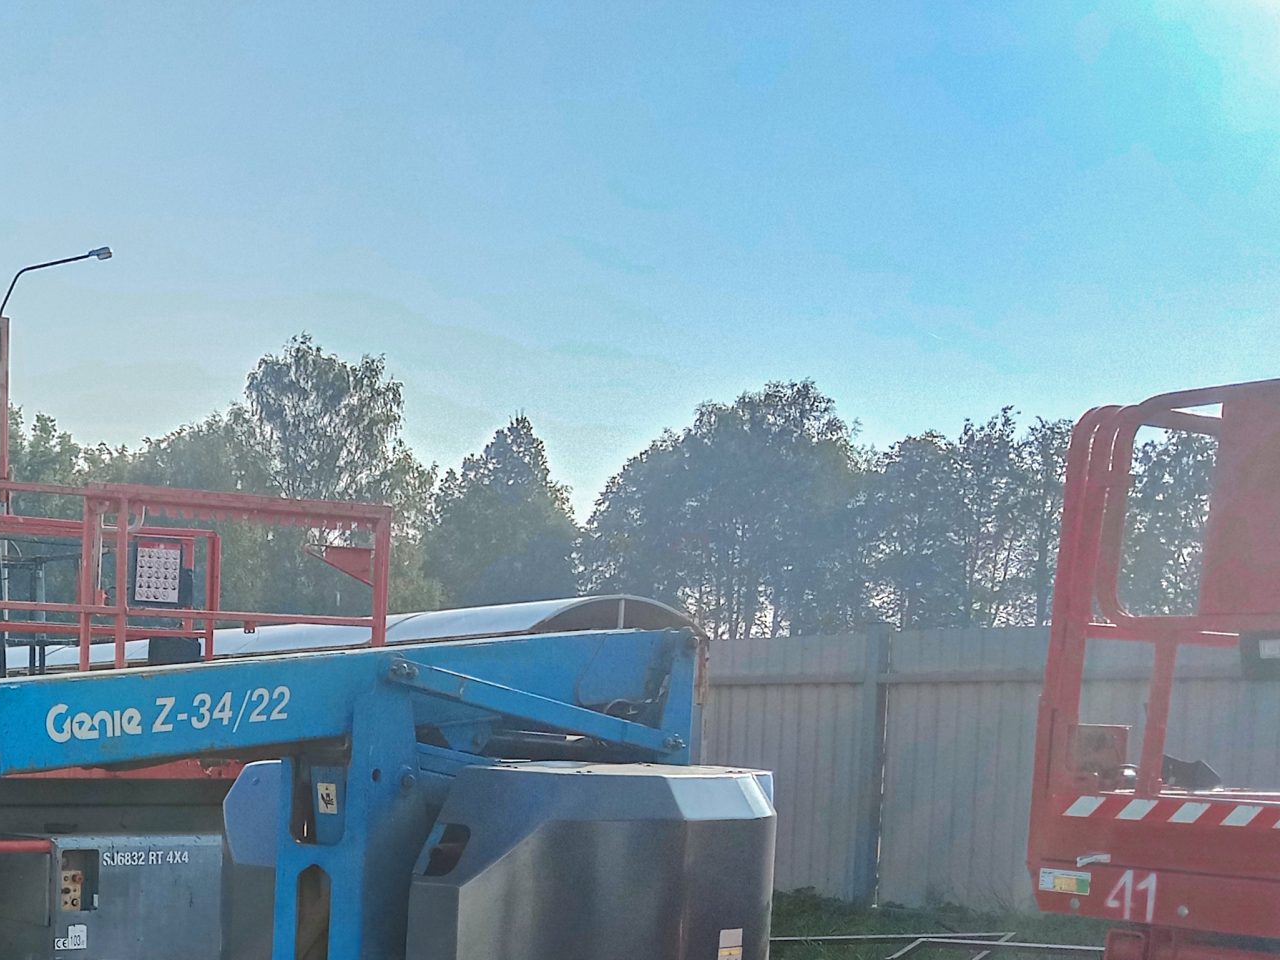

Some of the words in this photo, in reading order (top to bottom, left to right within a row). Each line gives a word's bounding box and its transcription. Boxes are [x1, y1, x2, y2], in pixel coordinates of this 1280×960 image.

[45, 703, 142, 743] Genie
[152, 686, 291, 733] Z-34/22
[102, 851, 145, 866] SJ6832
[148, 850, 164, 865] RT
[166, 850, 190, 864] 4X4
[1105, 868, 1158, 923] 41
[55, 939, 68, 949] CE
